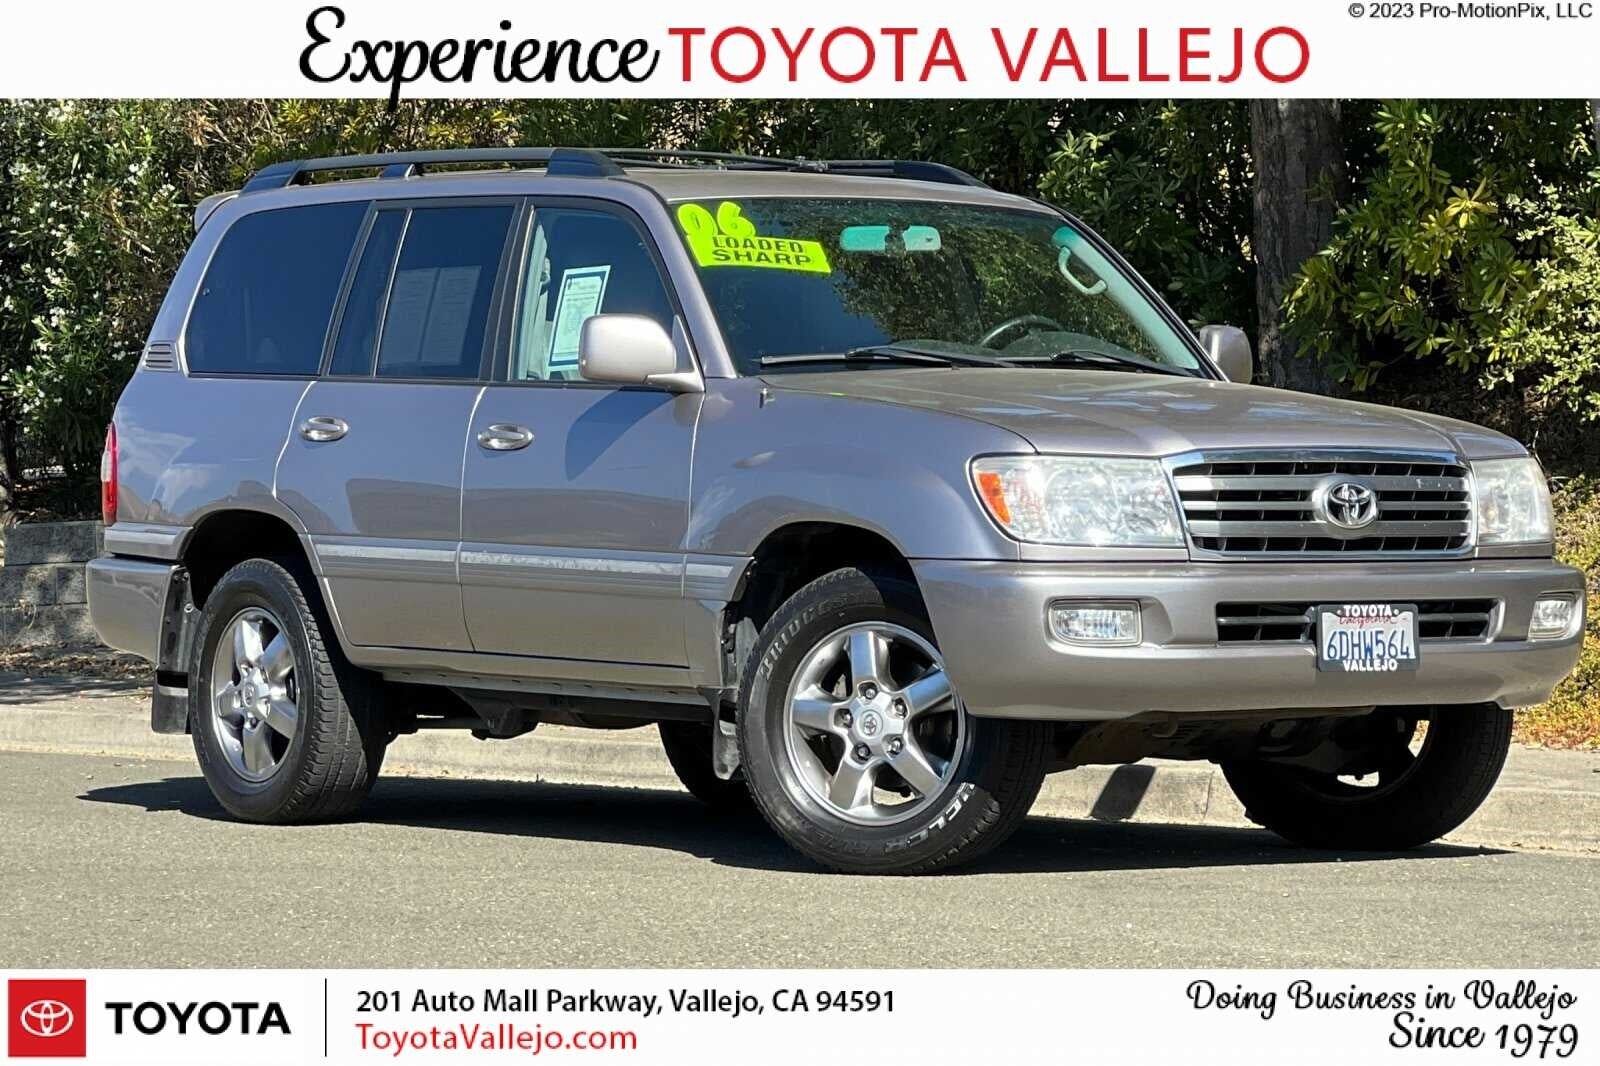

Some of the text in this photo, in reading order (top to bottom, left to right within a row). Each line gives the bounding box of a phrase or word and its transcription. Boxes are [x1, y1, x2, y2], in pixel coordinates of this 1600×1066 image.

[678, 201, 756, 237] 06
[712, 236, 804, 255] LOADED
[711, 249, 812, 266] SHARP
[1343, 604, 1393, 617] TOYOTA
[1326, 629, 1411, 659] 6DHW564
[1342, 658, 1399, 672] VALLEJO
